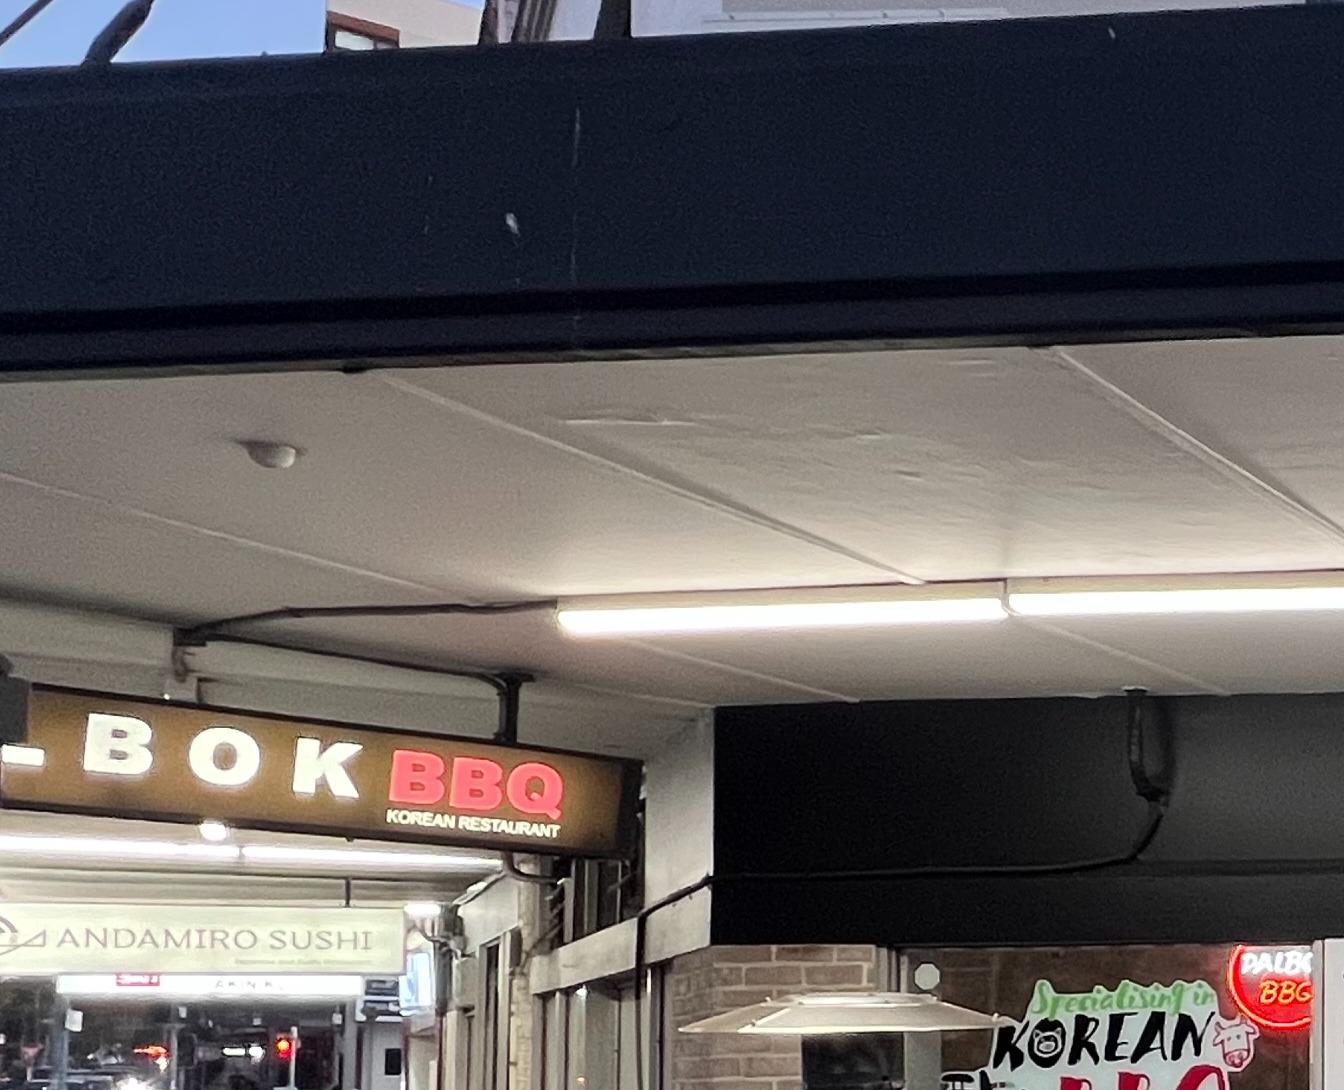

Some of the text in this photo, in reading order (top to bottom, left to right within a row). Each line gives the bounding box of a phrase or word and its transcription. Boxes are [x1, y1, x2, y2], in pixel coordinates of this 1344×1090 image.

[388, 749, 563, 820] BBQ
[386, 809, 561, 838] KOREAN RESTAURANT
[56, 927, 373, 951] ANDAMIRO SUSHI
[1031, 980, 1185, 1018] Specialising
[992, 1010, 1216, 1072] KOREAN
